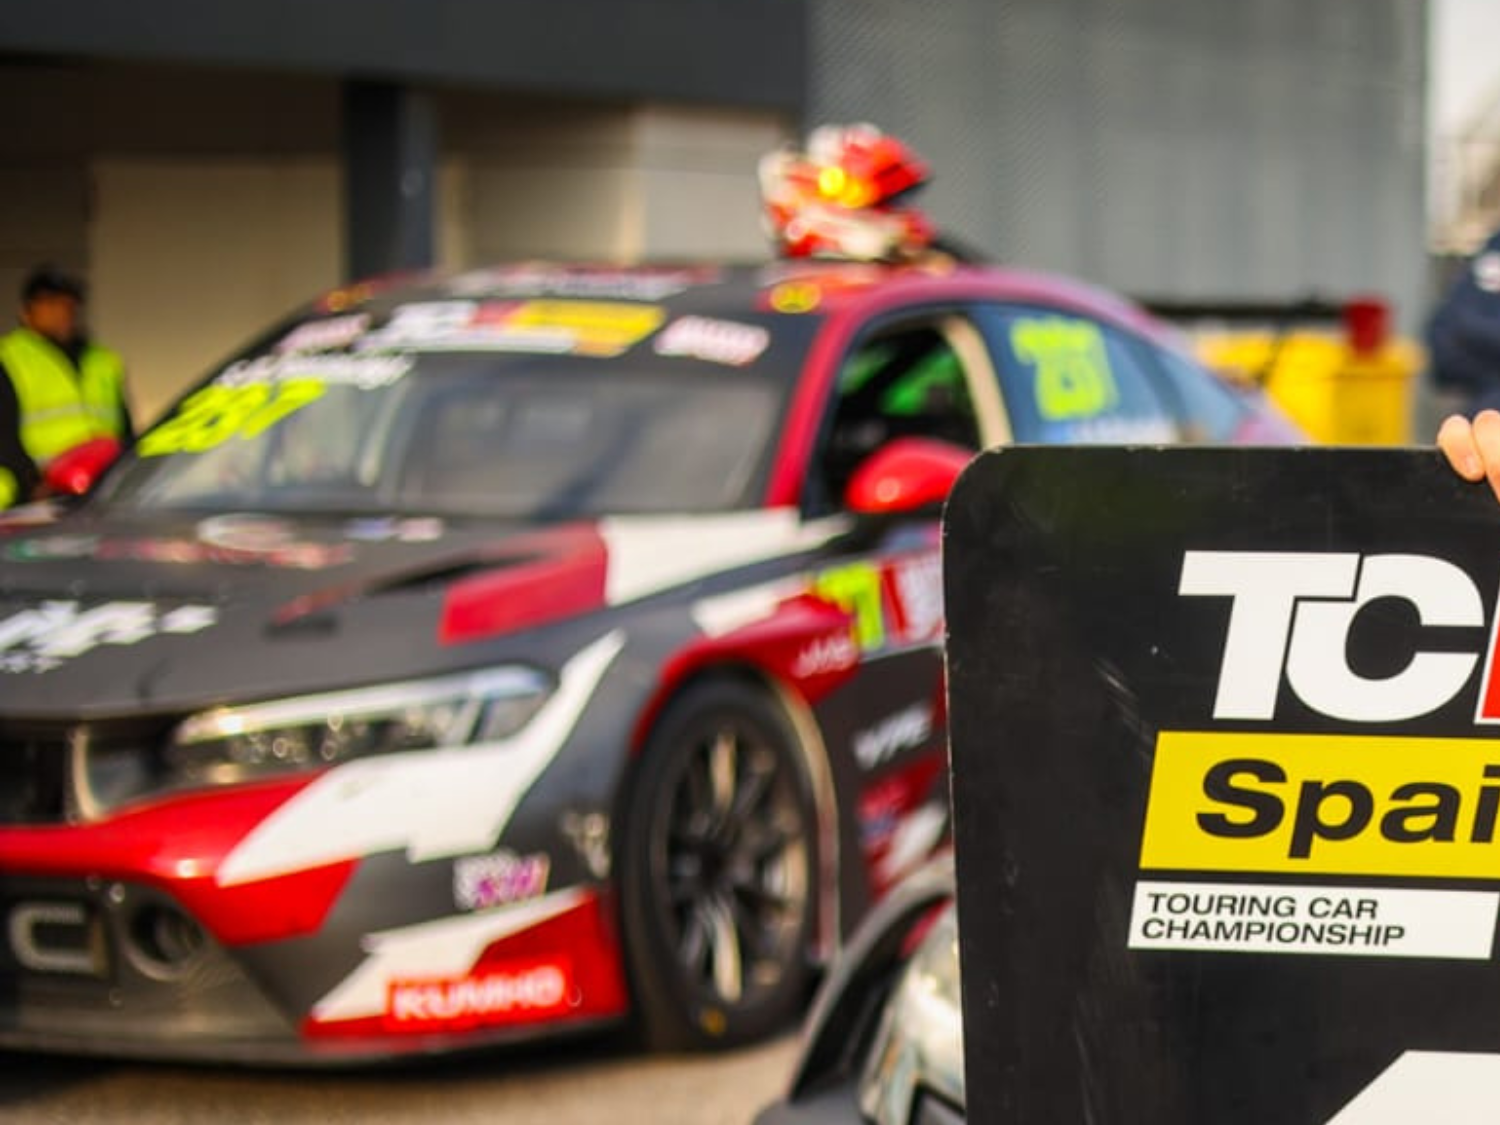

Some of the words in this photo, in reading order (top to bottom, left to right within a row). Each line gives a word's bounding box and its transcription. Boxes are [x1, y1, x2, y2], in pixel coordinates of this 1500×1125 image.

[1147, 891, 1298, 918] TOURING
[1307, 897, 1379, 920] CAR
[1140, 919, 1406, 948] CHAMPIONSHIP
[392, 965, 566, 1020] KUMHO
